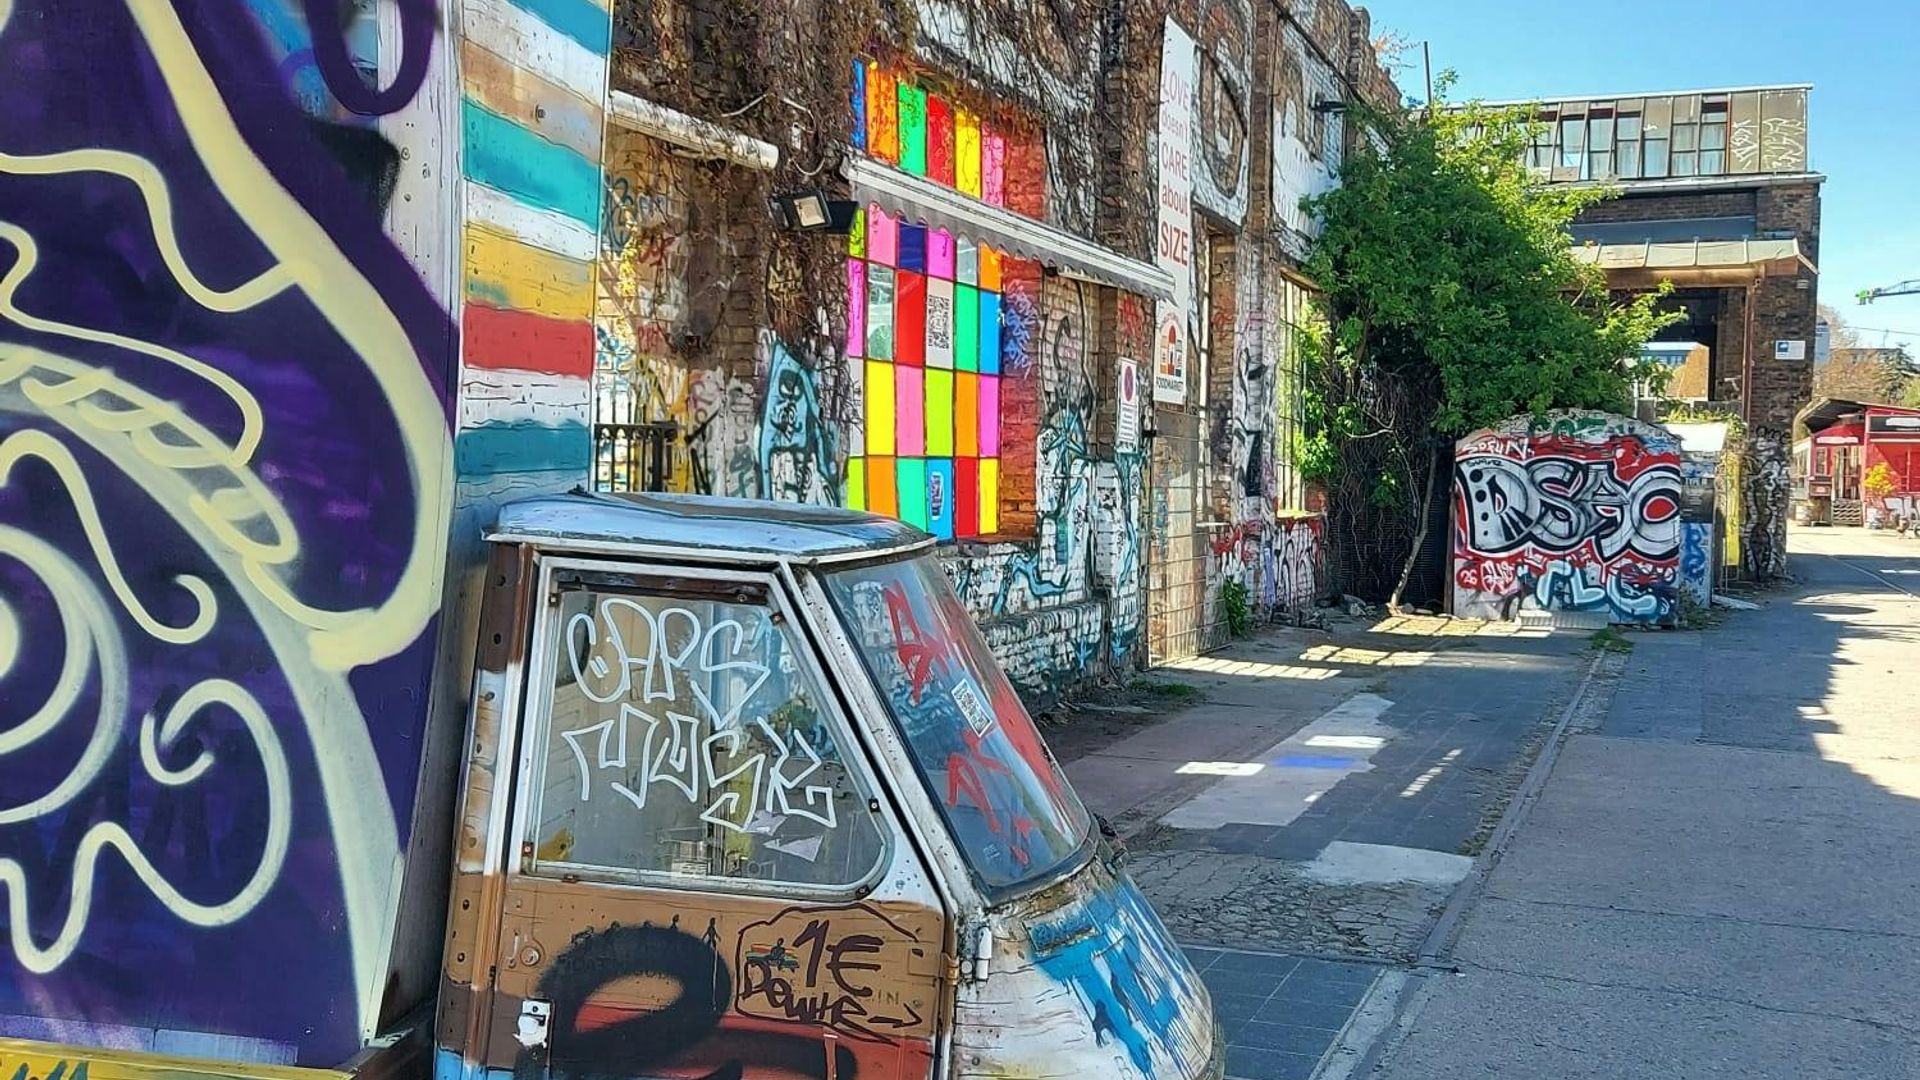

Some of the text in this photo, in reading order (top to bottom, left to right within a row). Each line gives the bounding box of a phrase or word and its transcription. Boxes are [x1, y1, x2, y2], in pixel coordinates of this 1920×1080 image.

[1161, 66, 1189, 111] LOVE
[1161, 142, 1188, 182] CARE
[1161, 180, 1188, 217] about
[1160, 220, 1188, 266] SIZE
[792, 919, 884, 997] 1€
